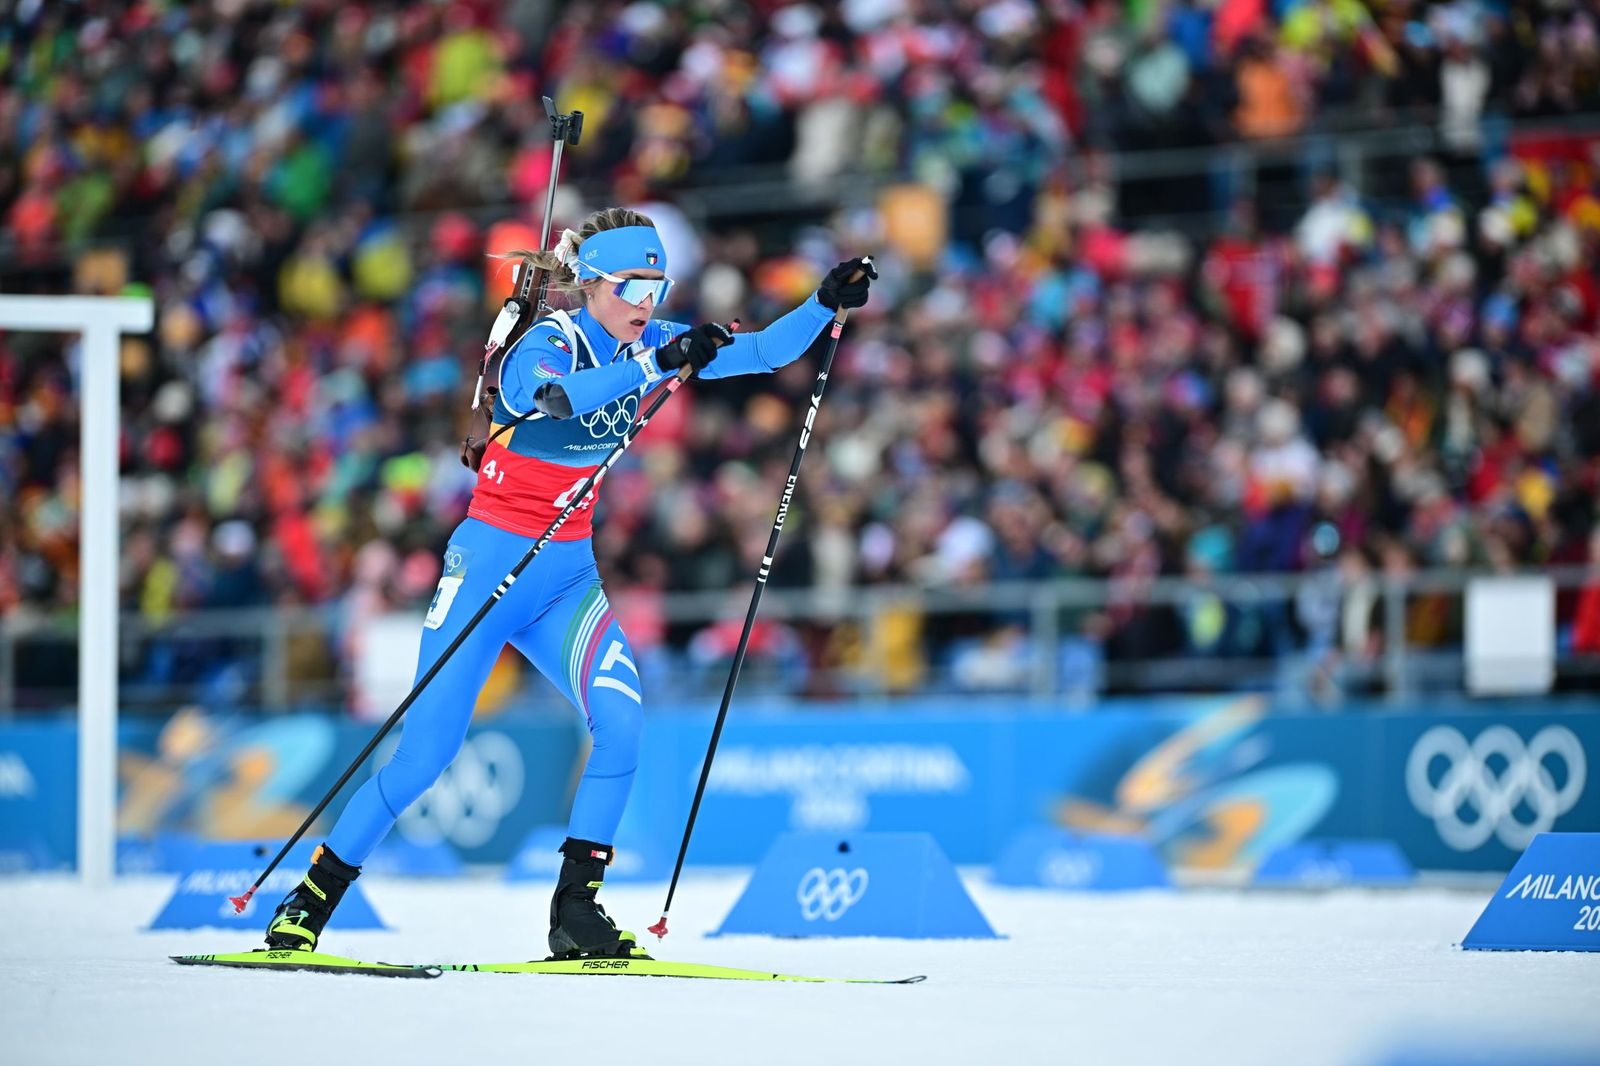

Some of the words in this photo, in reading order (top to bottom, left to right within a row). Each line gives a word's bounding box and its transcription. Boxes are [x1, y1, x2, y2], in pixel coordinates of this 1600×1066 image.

[592, 627, 642, 705] IT
[1573, 905, 1600, 930] 20
[582, 960, 630, 970] FISCHER
